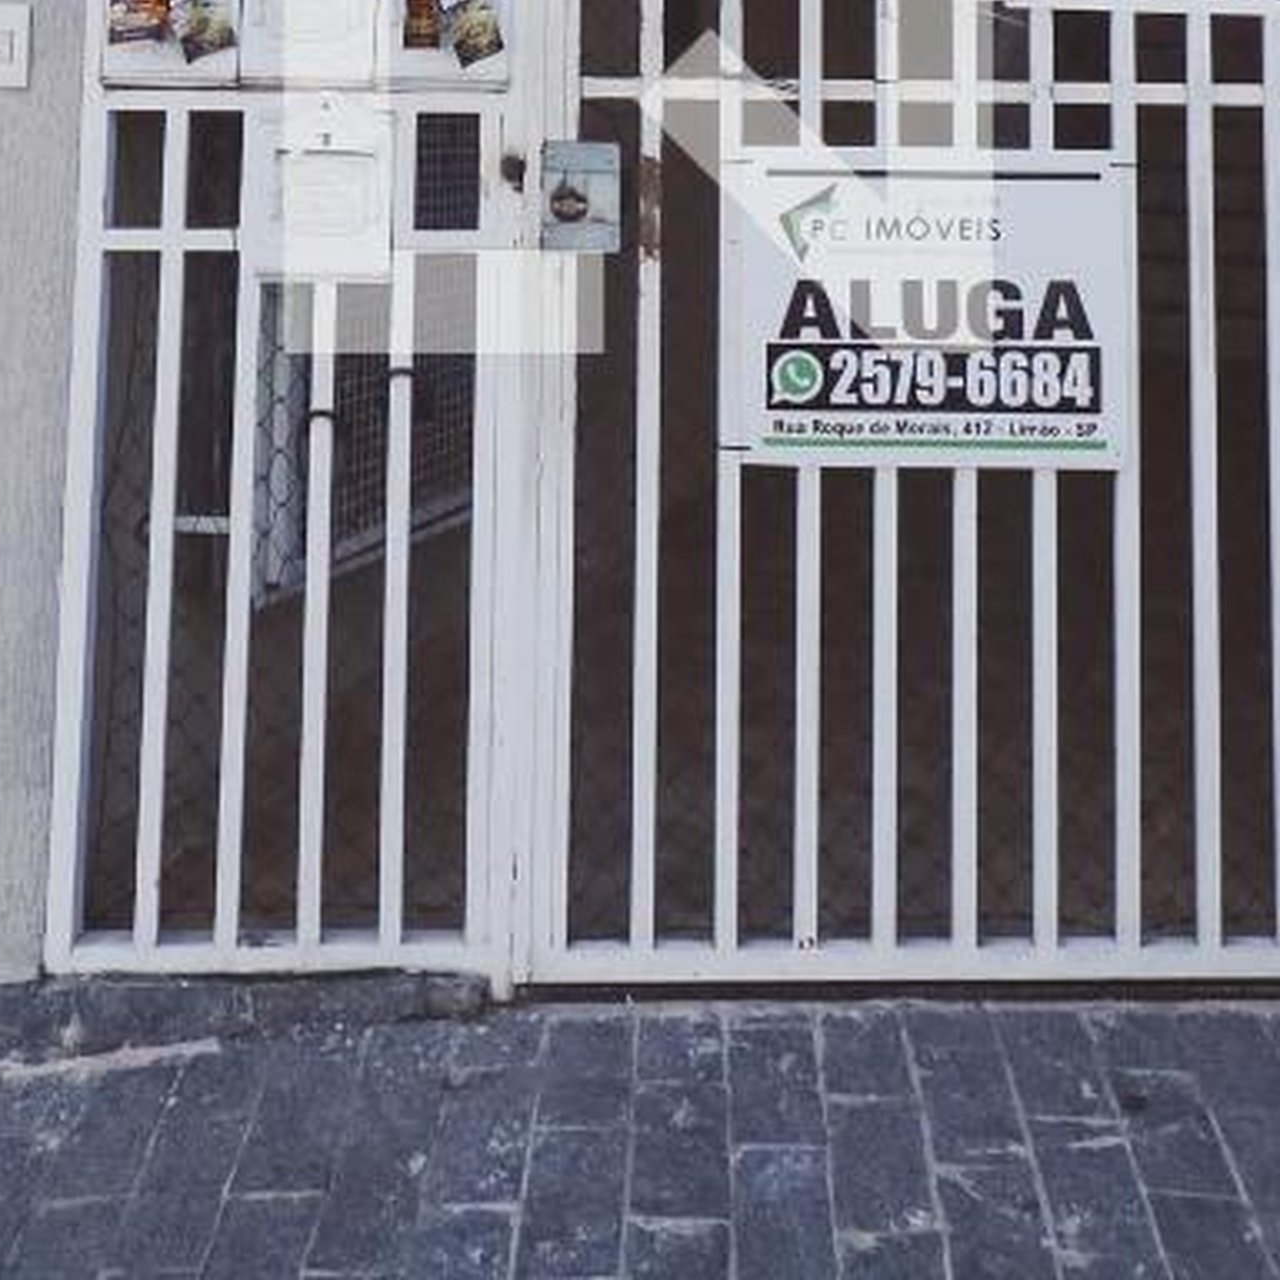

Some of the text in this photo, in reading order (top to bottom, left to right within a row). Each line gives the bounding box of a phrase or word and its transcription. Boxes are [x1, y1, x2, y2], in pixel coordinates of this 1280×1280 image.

[778, 279, 1096, 341] ALUGA
[829, 349, 1093, 408] 2579-6684
[773, 419, 807, 434] Rua
[812, 418, 864, 439] Roque
[870, 419, 891, 434] de
